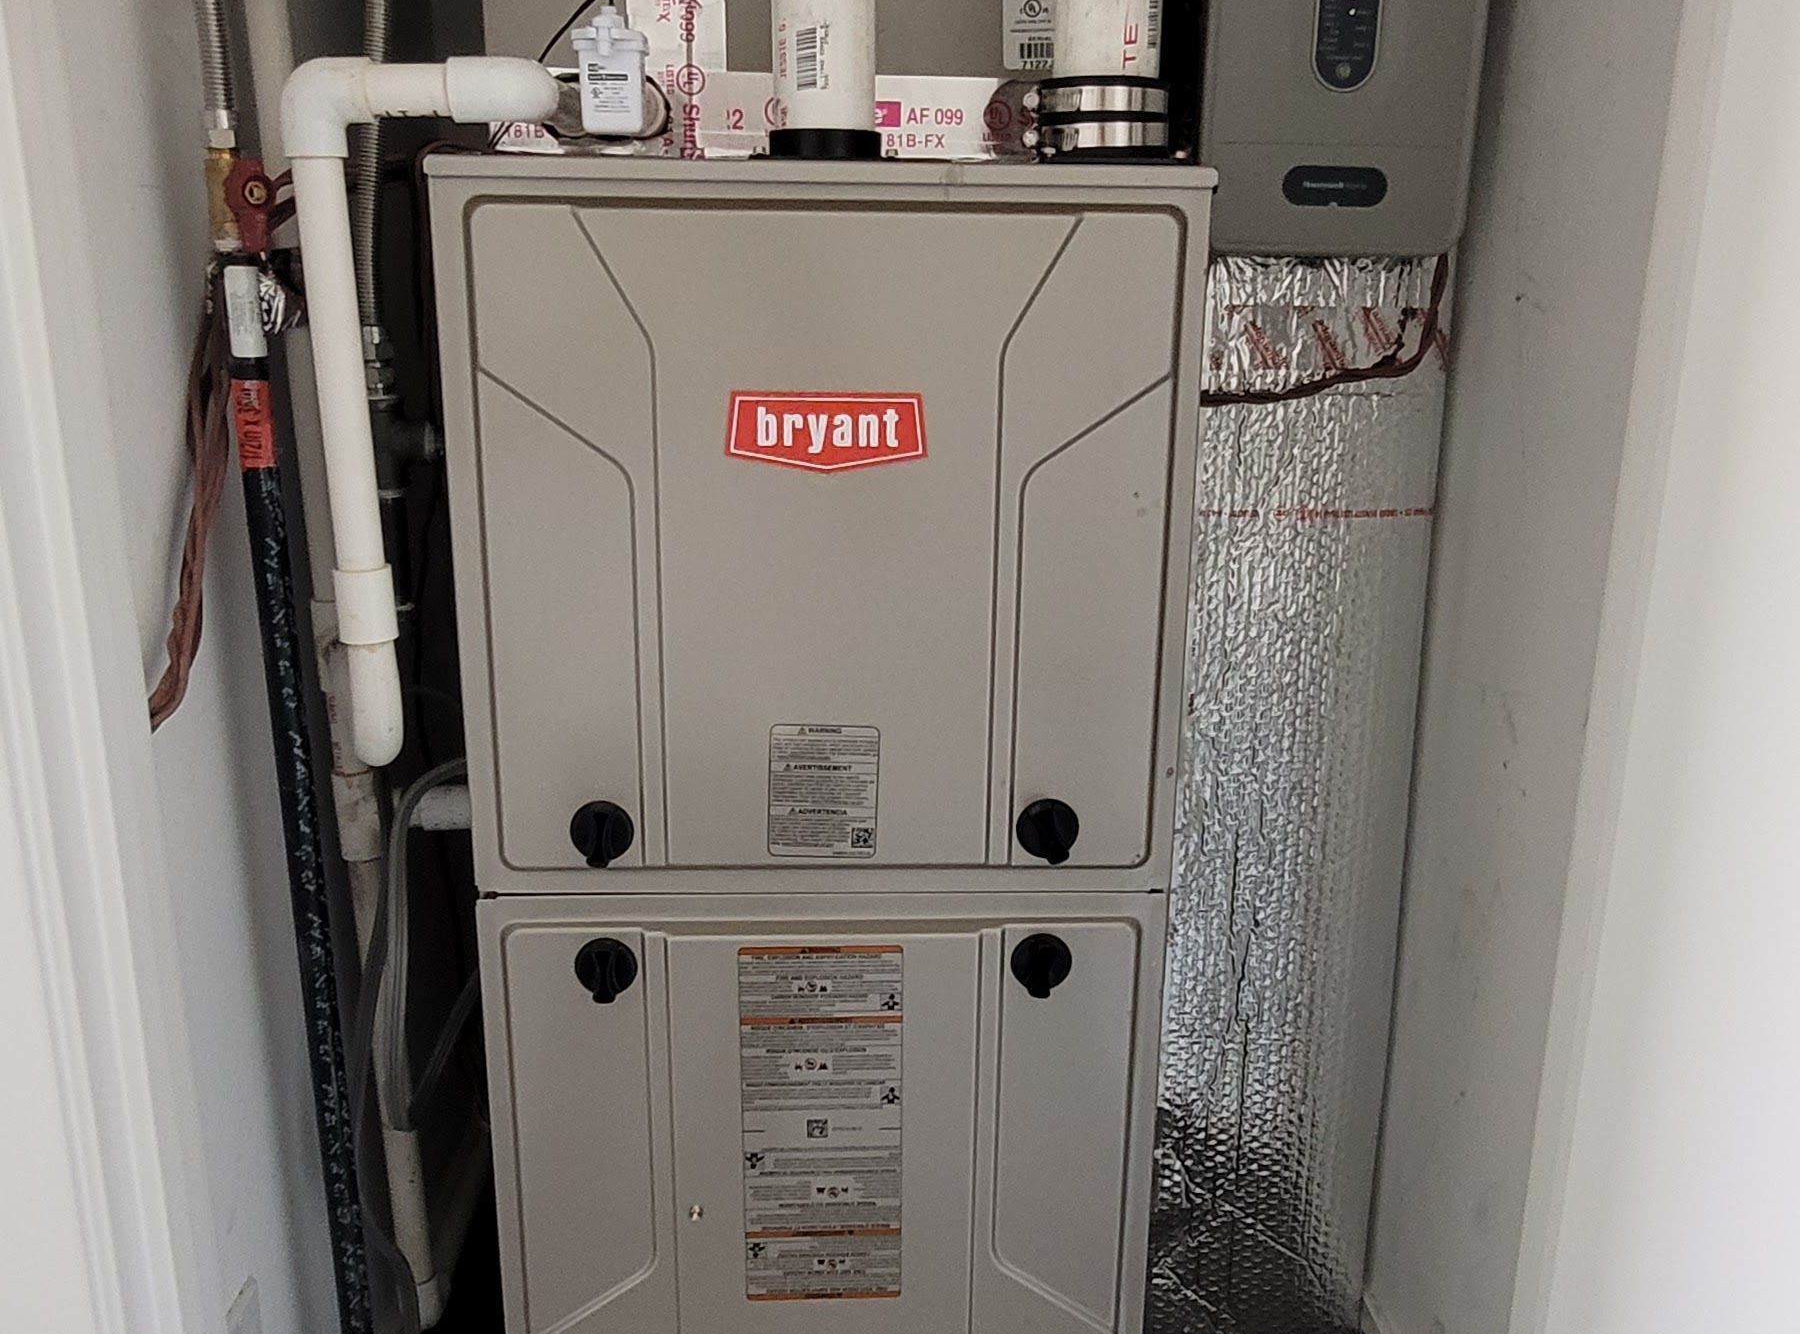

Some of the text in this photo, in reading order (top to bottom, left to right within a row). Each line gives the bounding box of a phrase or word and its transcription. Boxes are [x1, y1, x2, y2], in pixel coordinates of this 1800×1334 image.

[1121, 24, 1138, 70] TE
[907, 107, 964, 126] AF 099
[756, 407, 899, 454] bryant
